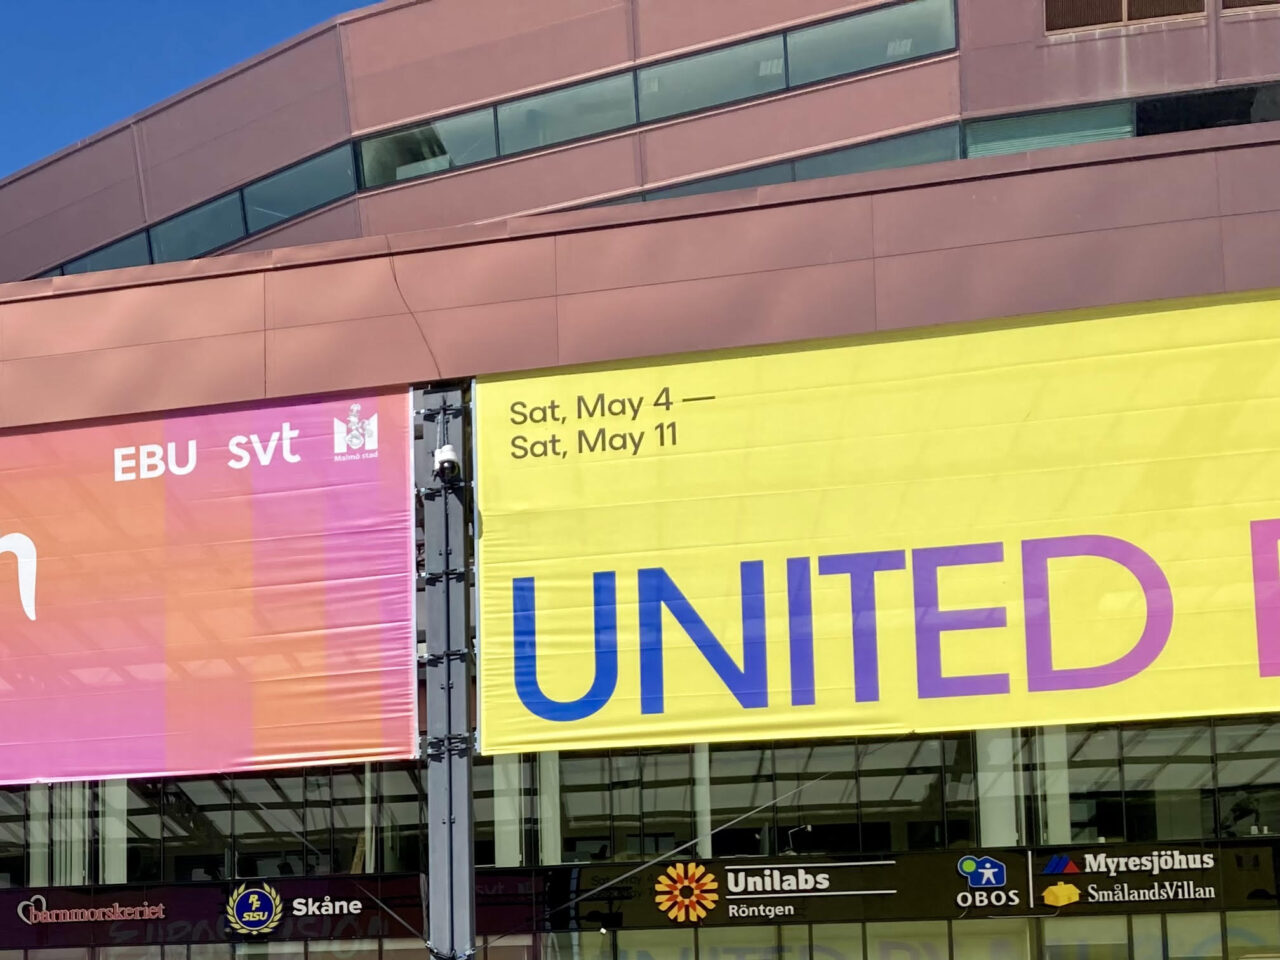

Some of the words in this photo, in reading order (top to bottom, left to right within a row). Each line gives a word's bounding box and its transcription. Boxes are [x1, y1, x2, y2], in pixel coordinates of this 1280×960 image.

[510, 400, 567, 425] Sat,
[577, 393, 644, 421] May
[653, 386, 673, 411] 4
[227, 422, 301, 469] svt
[510, 434, 568, 459] Sat,
[578, 428, 645, 455] May
[654, 421, 677, 447] 11
[114, 440, 197, 482] EBU
[362, 450, 379, 458] stad
[512, 534, 1173, 722] UNITED
[1084, 850, 1214, 876] Myresjöhus
[727, 868, 830, 893] Unilabs
[1088, 881, 1216, 903] SmålandsVillan
[292, 896, 362, 916] Skåne
[956, 890, 1020, 907] OBOS
[29, 901, 166, 923] barnmorskeriet
[242, 911, 268, 921] SISU
[728, 904, 794, 918] Röntgen
